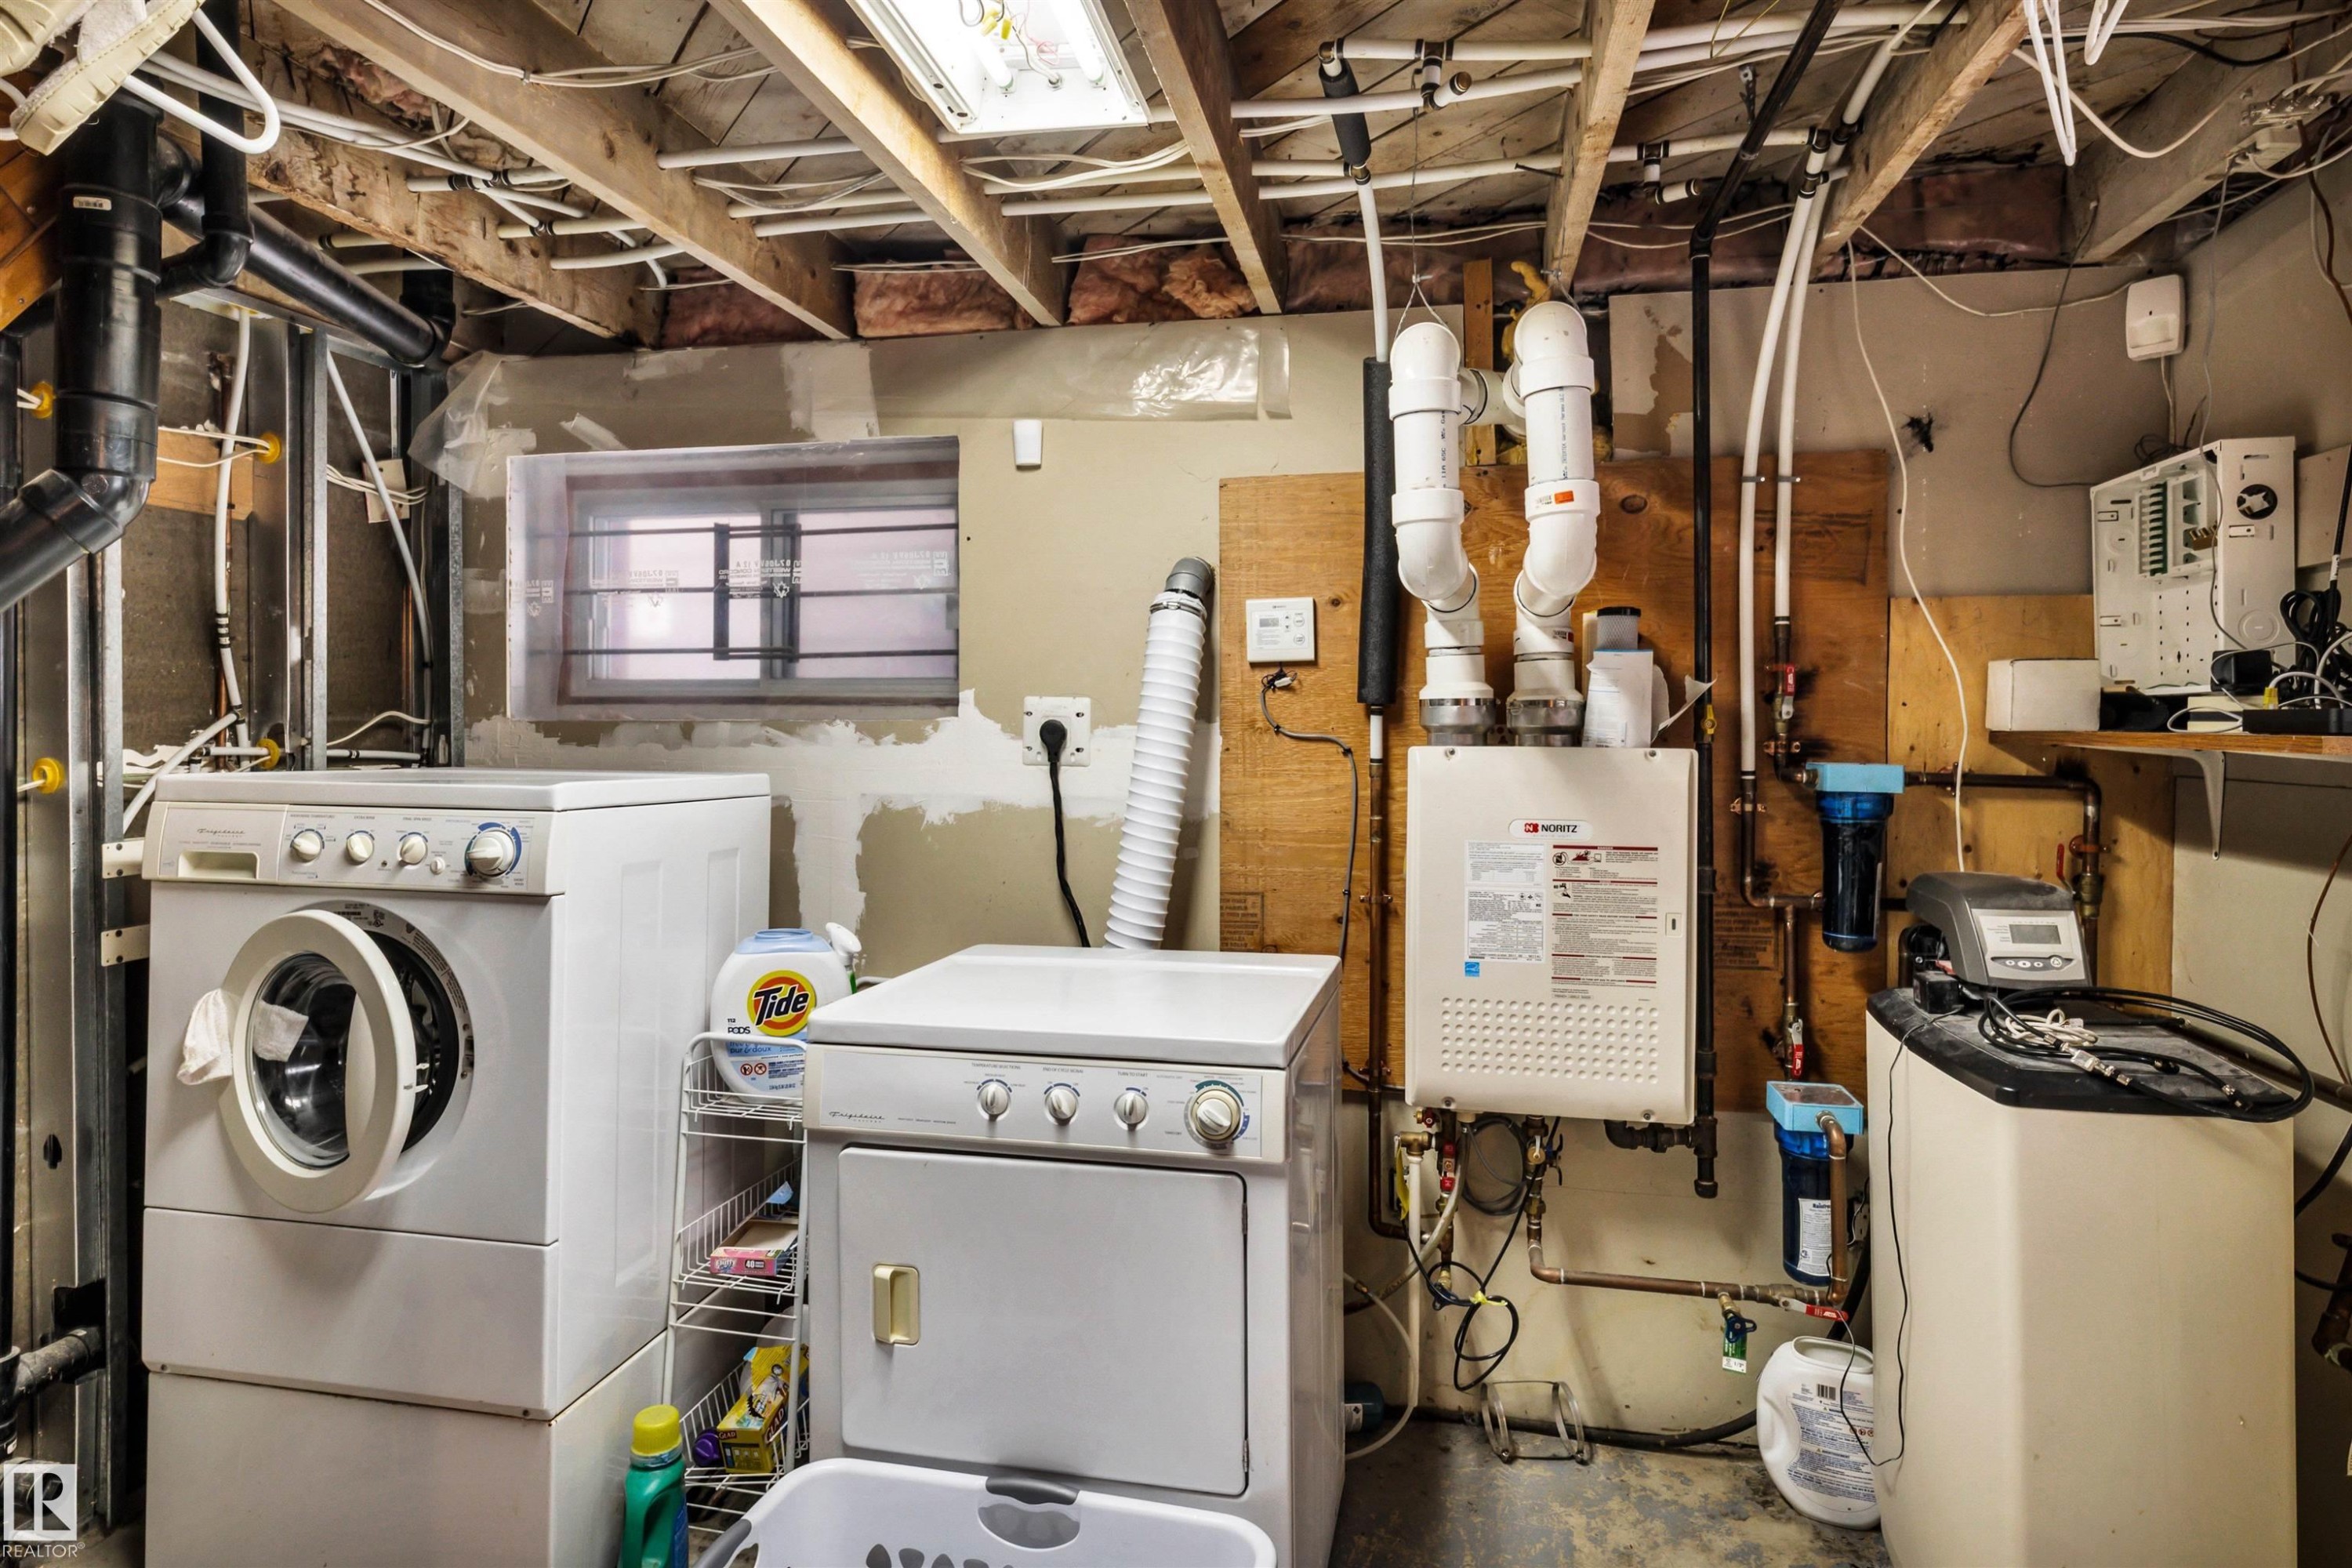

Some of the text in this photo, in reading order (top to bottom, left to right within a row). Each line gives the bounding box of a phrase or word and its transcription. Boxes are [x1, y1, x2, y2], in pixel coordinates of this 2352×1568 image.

[1541, 824, 1577, 833] NORITZ
[753, 984, 809, 1026] Tide
[746, 1260, 755, 1269] 40
